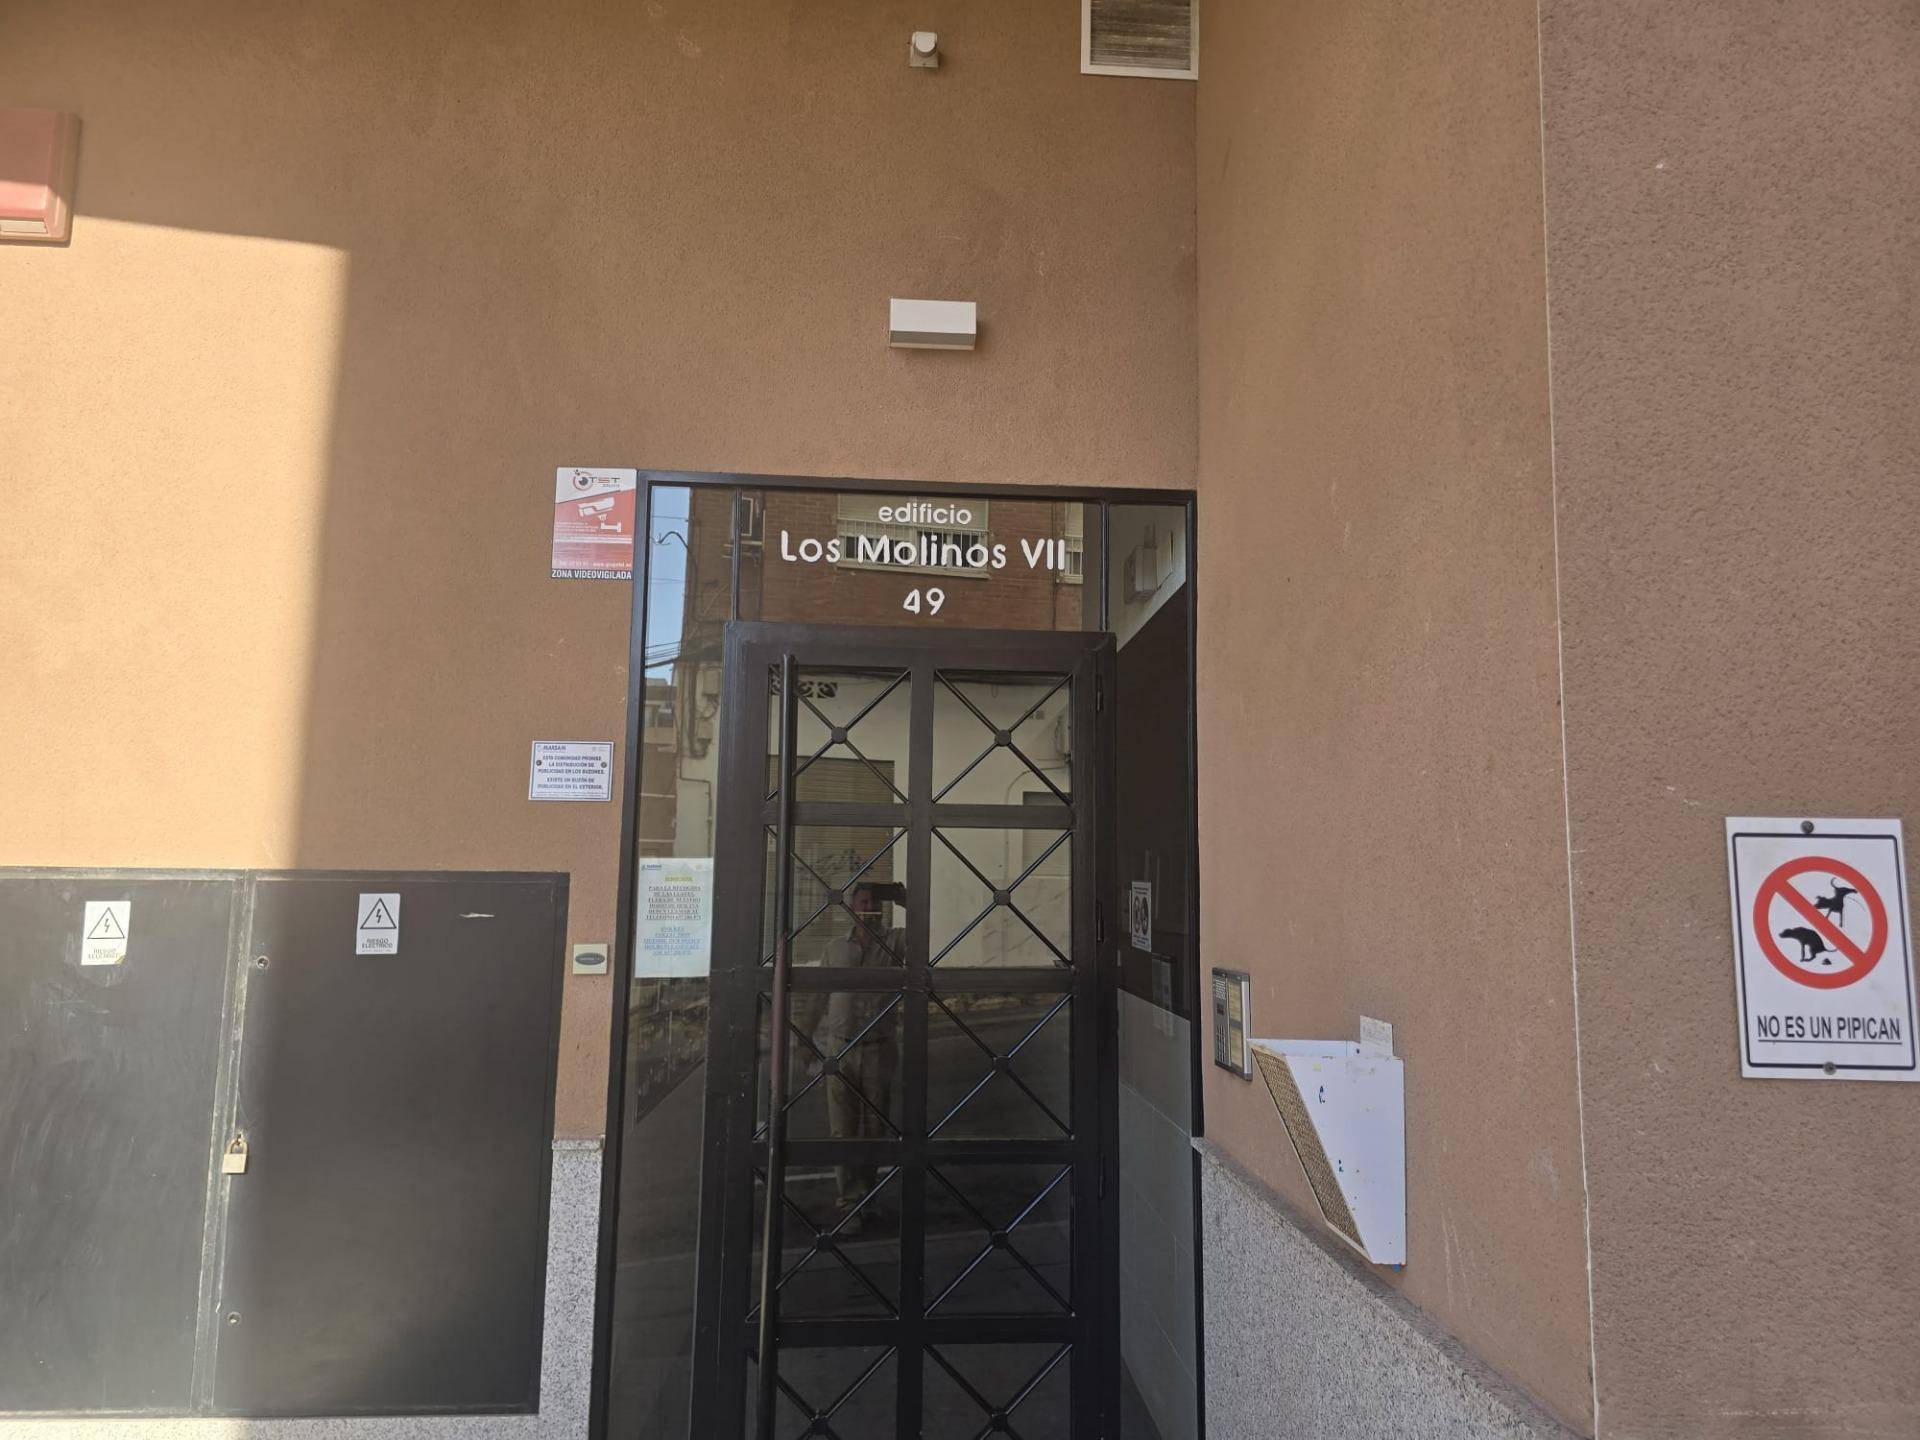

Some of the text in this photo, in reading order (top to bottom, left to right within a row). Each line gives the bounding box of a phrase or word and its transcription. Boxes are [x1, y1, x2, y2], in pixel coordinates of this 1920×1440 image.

[878, 503, 972, 525] edificio
[781, 530, 1065, 570] Los Molinos VII
[552, 569, 632, 579] ZONA VIDEOVIGILADA
[902, 587, 945, 615] 49
[1757, 1015, 1901, 1040] NO ES UN PIPICAN
